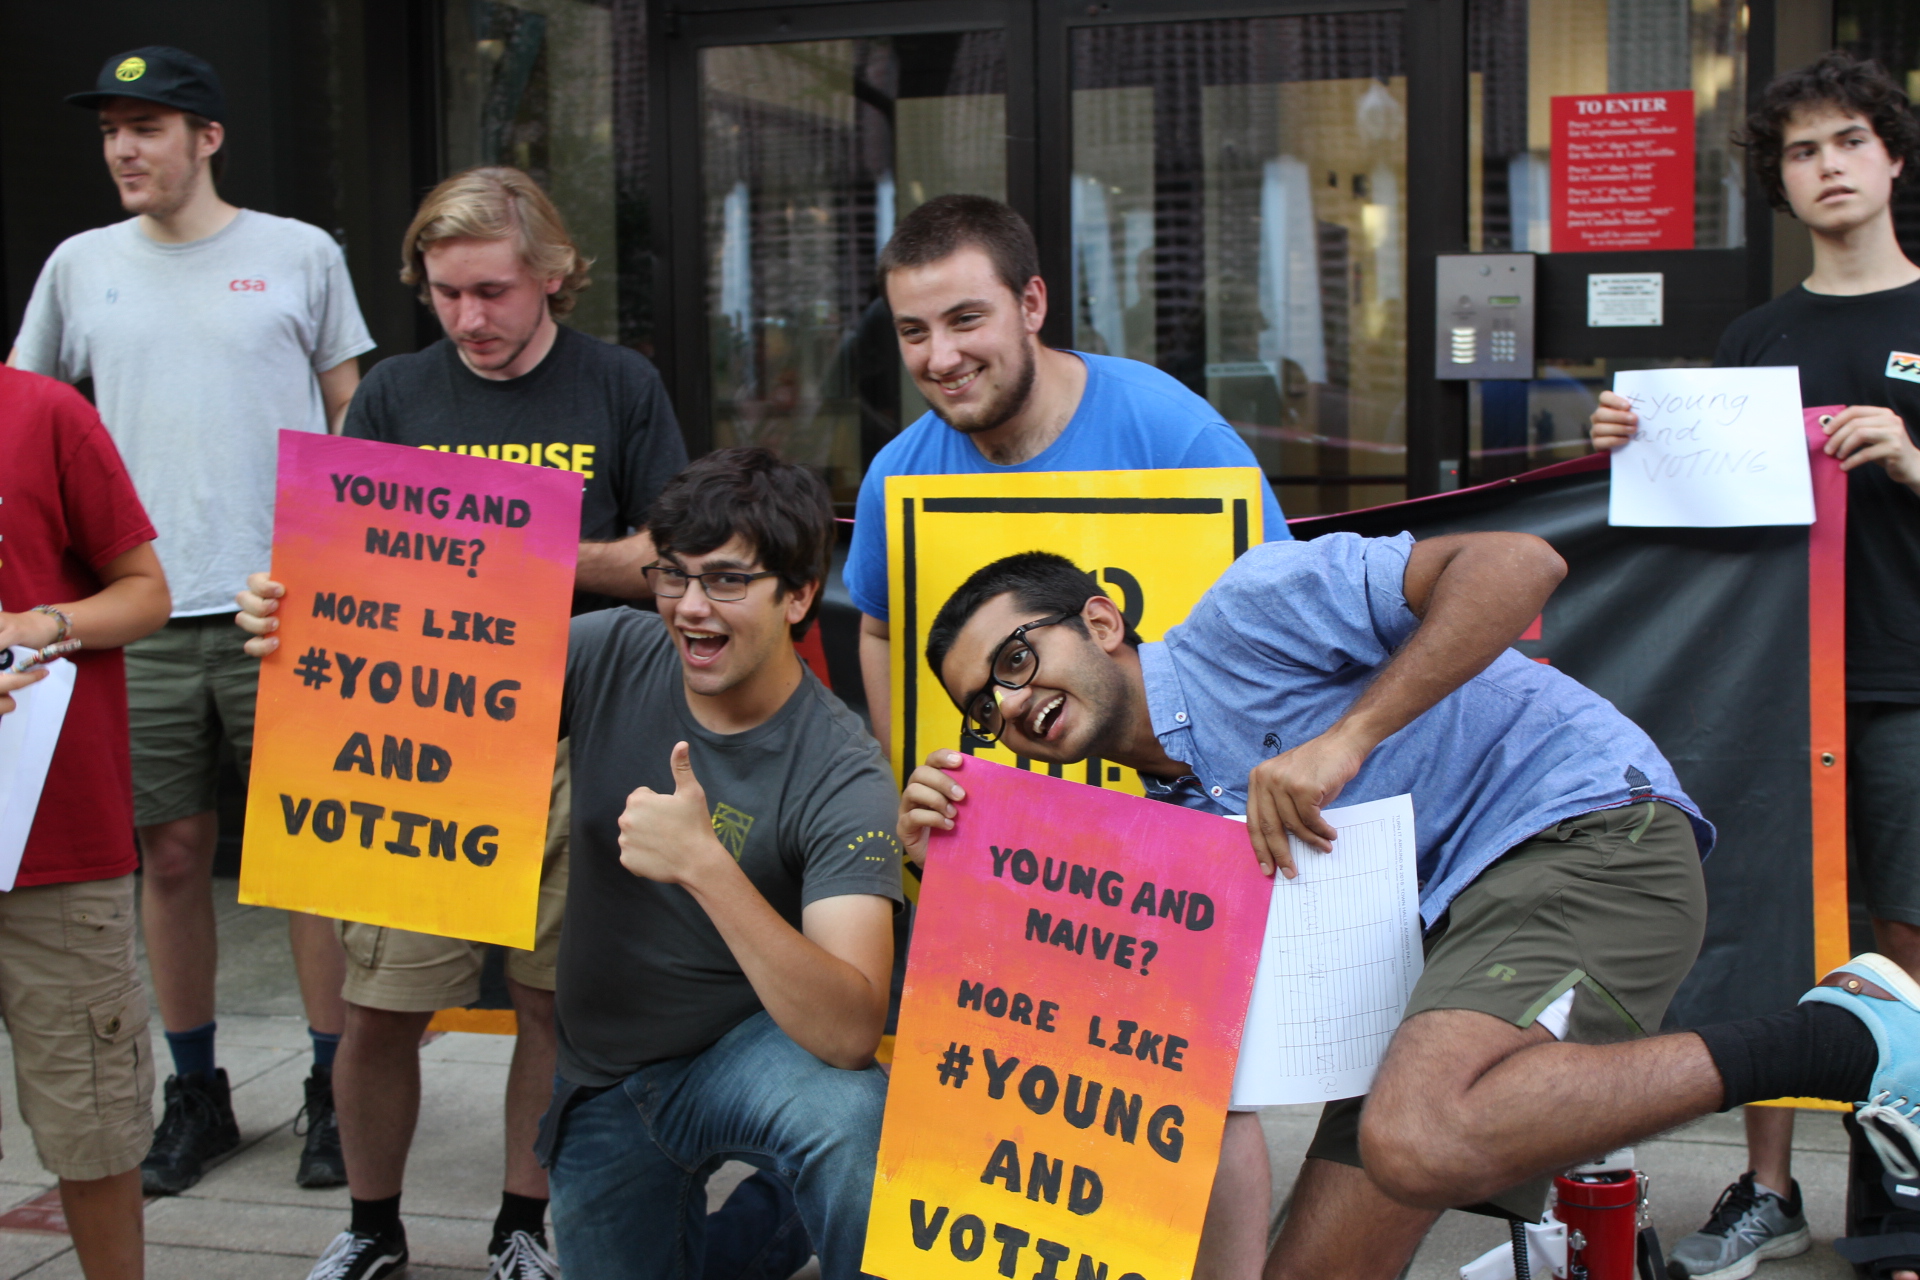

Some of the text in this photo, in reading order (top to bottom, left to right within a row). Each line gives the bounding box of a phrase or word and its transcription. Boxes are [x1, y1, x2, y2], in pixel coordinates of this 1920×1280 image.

[1575, 97, 1667, 115] TO ENTER
[229, 280, 266, 292] csa
[1642, 448, 1768, 482] VOTING
[330, 473, 531, 528] YOUNG AND
[365, 527, 486, 579] NAIVE?
[312, 592, 516, 646] MORE LIKE
[293, 646, 522, 722] #YOUNG
[333, 732, 452, 783] AND
[279, 793, 499, 867] VOTING
[989, 845, 1215, 932] YOUNG AND
[1025, 908, 1159, 976] NAIVE?
[957, 979, 1189, 1072] MORE LIKE
[936, 1042, 1185, 1164] #YOUNG
[980, 1139, 1104, 1216] AND
[909, 1199, 1148, 1280] VOTIN
